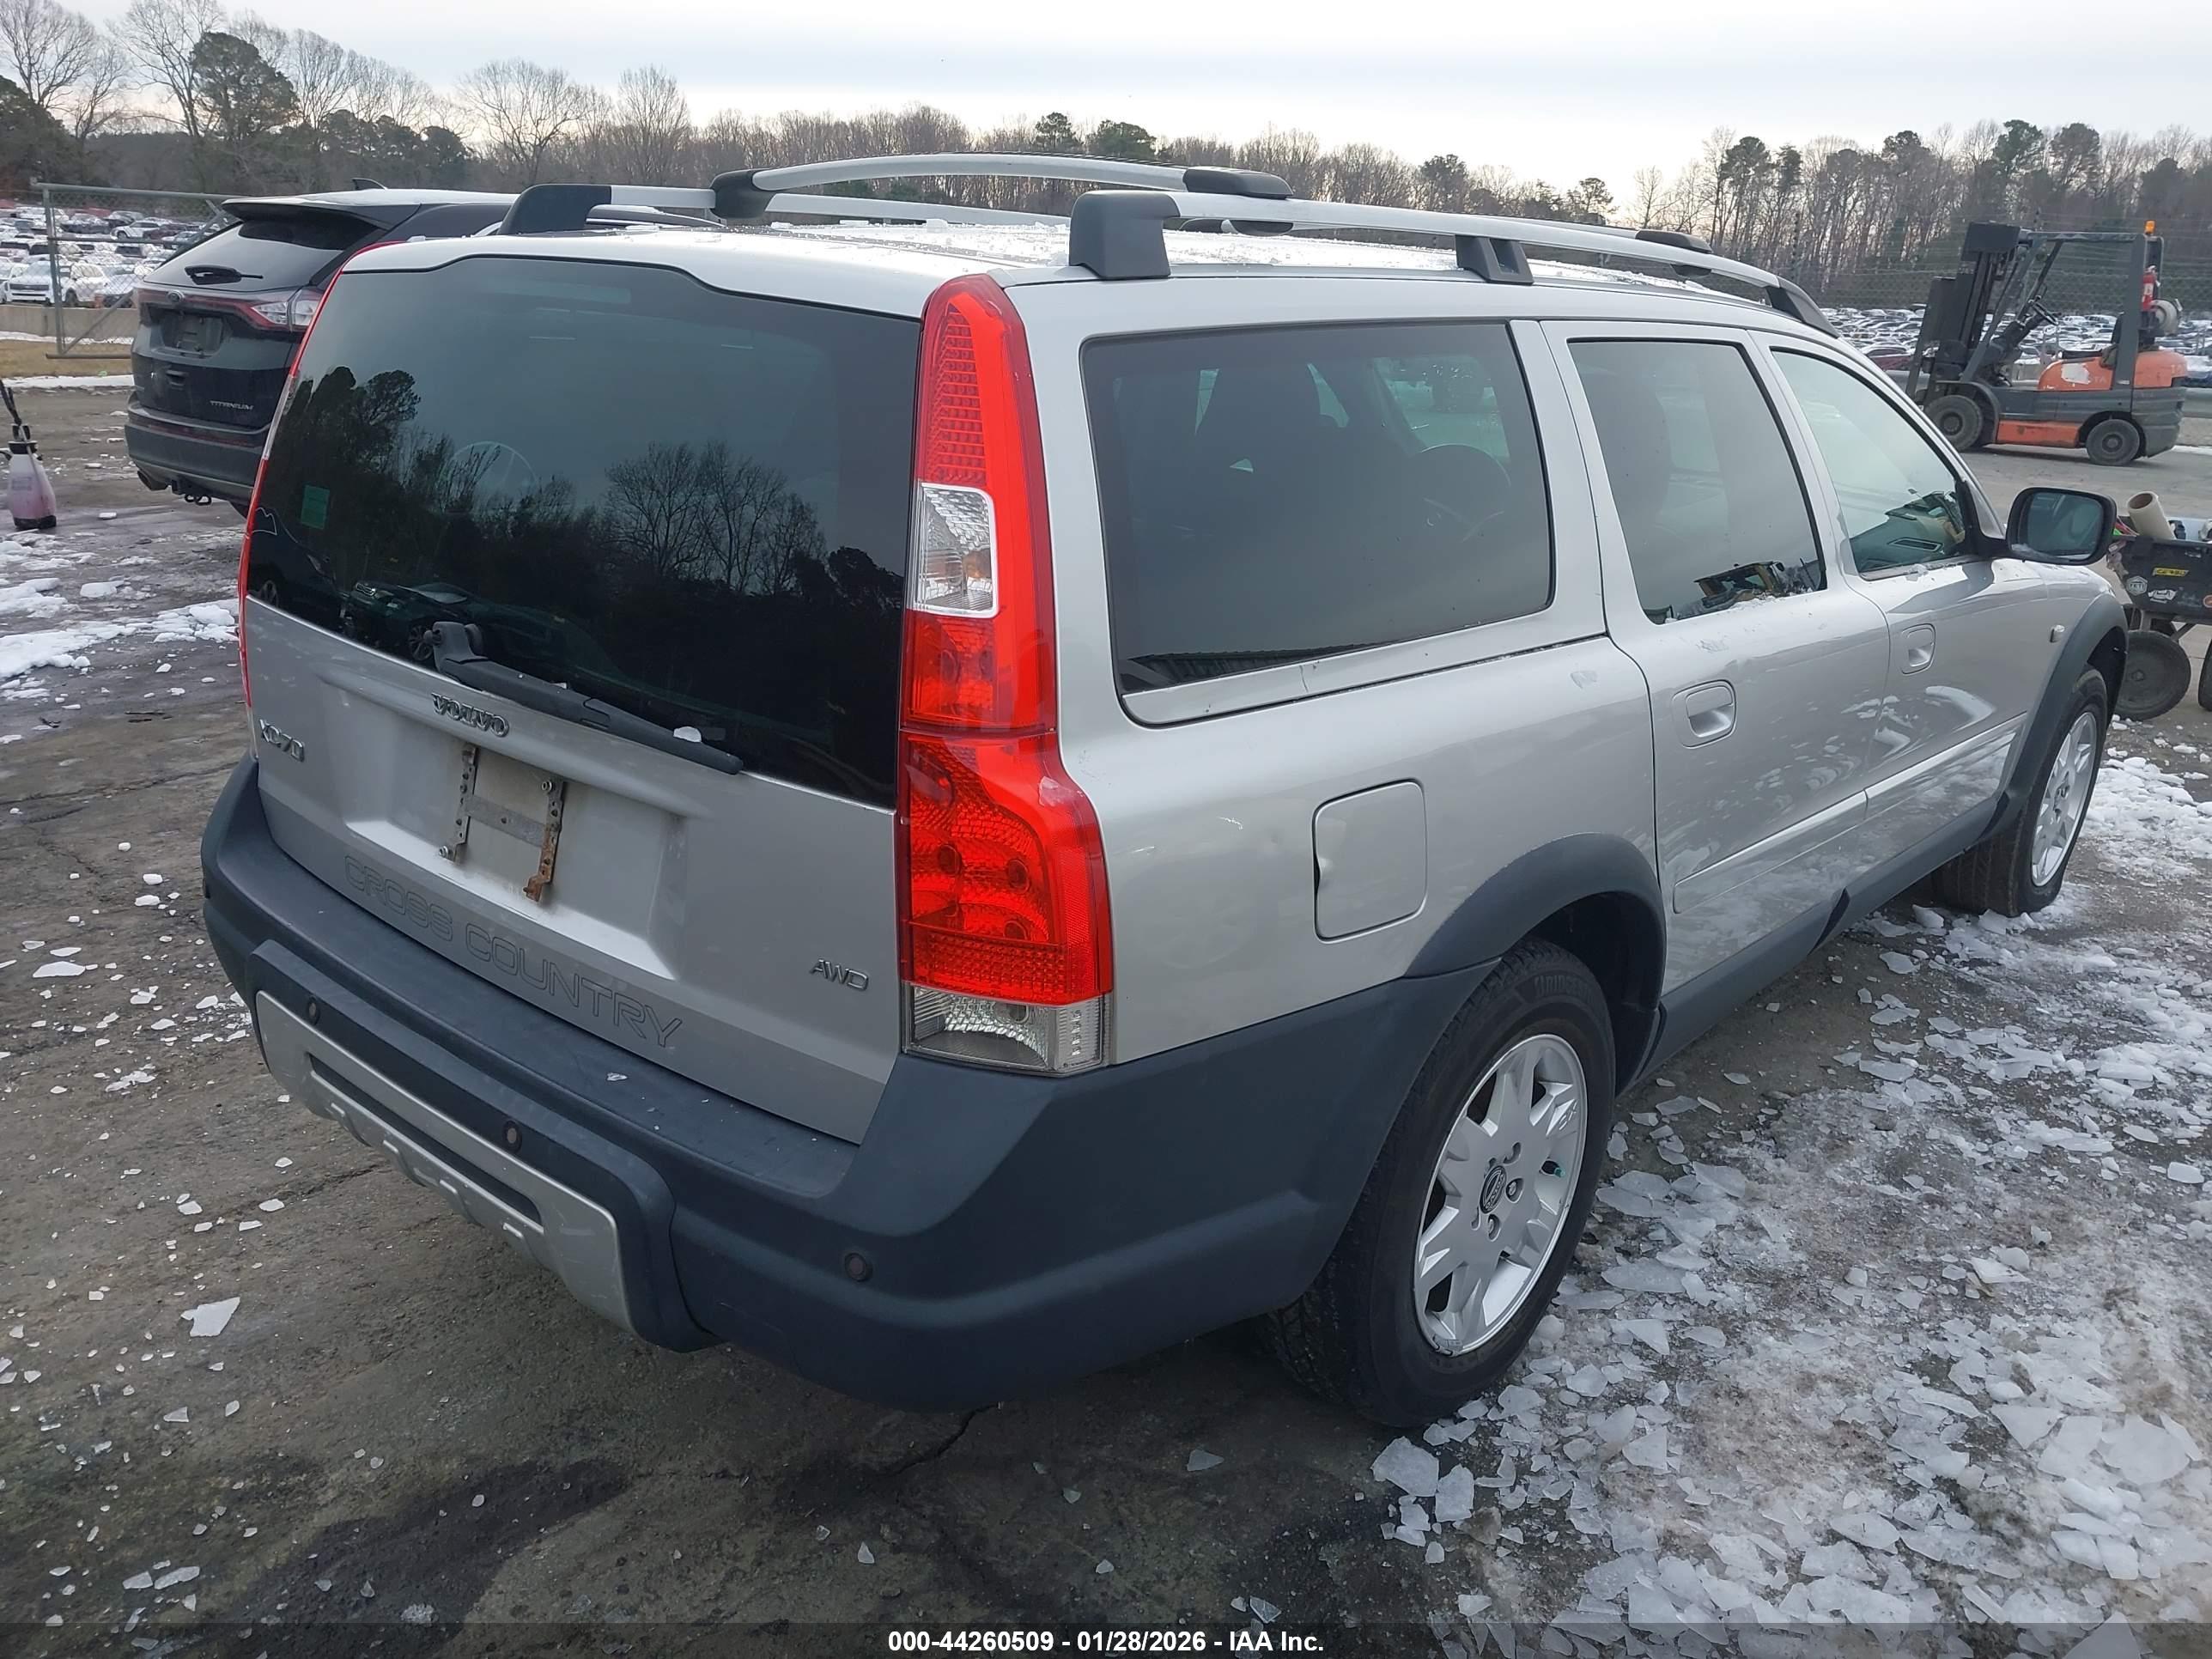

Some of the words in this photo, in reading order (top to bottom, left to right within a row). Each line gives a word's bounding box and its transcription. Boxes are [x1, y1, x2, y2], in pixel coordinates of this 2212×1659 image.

[210, 400, 254, 410] TITANIUM
[431, 692, 509, 738] VOLVO
[259, 719, 305, 763] XC70
[344, 855, 453, 942] CROSS
[465, 923, 683, 1048] COUNTRY
[810, 958, 869, 991] AWD
